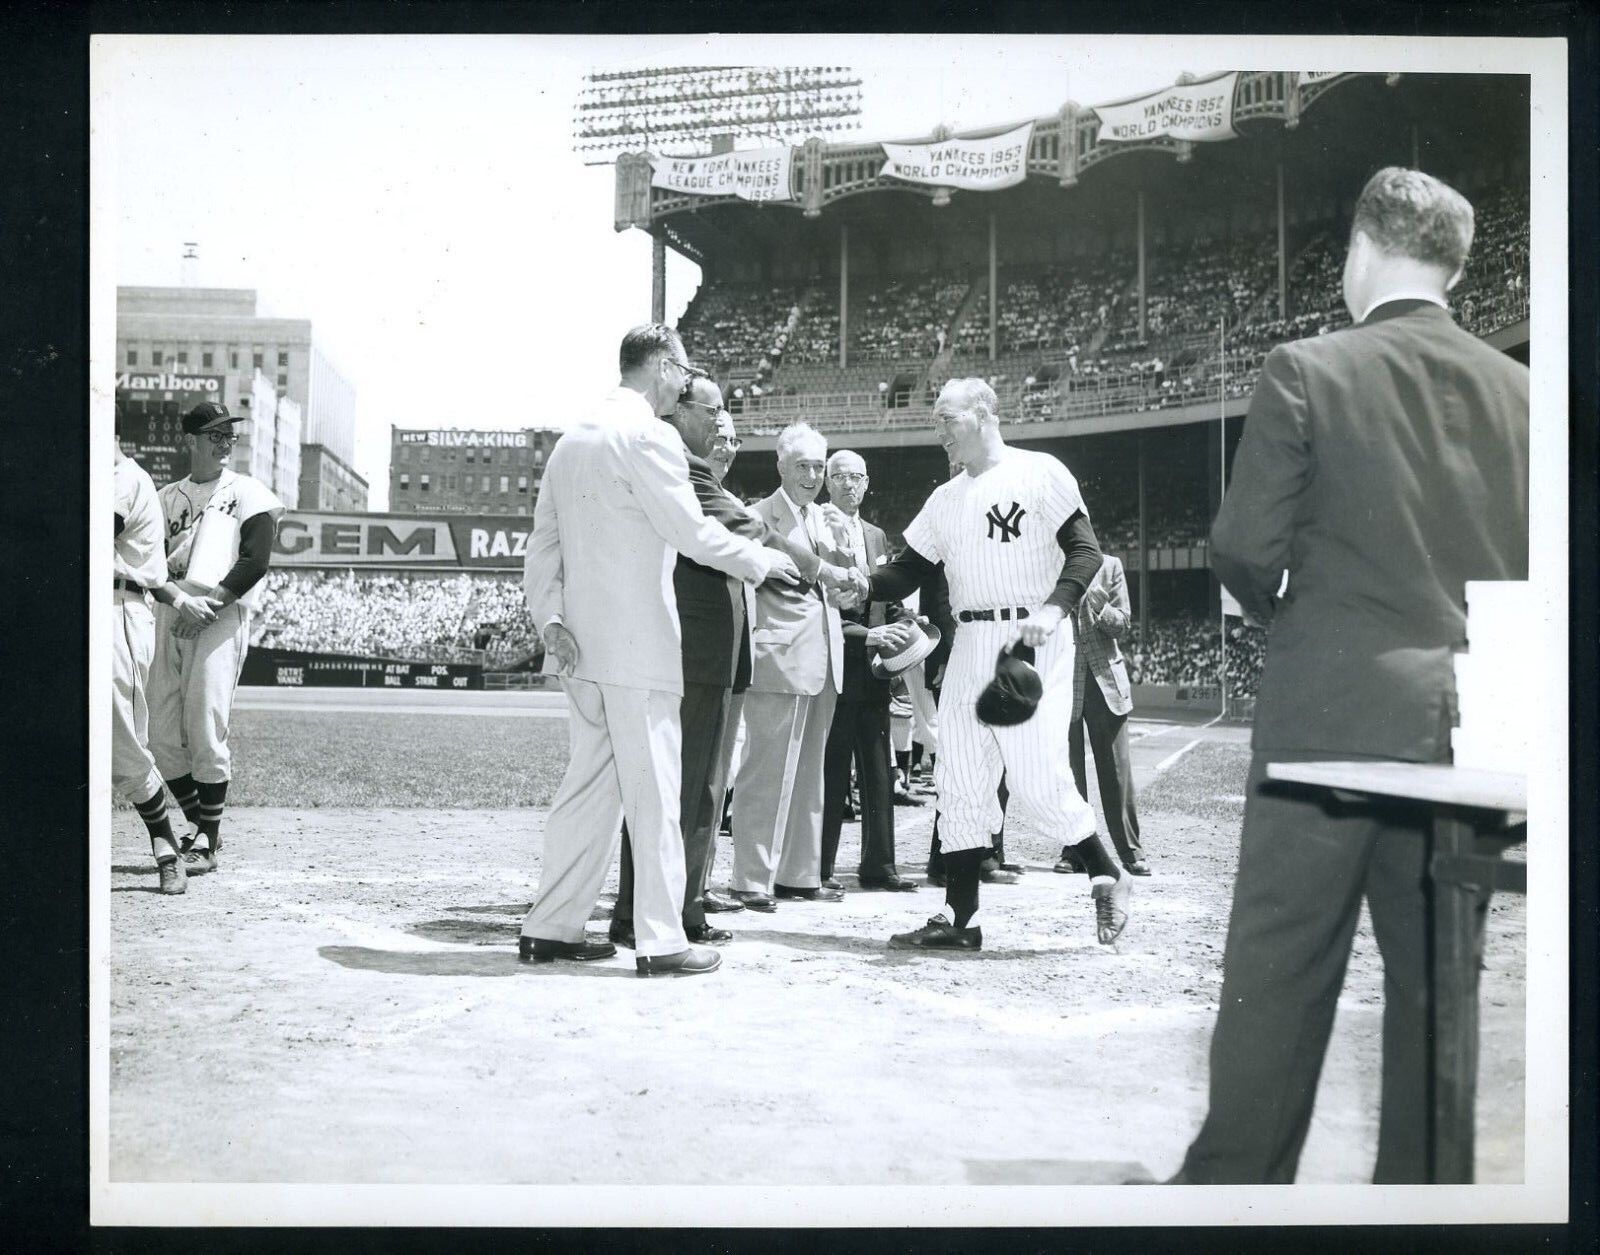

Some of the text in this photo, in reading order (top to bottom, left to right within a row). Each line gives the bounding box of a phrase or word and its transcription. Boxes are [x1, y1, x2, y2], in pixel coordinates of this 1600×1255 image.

[1112, 120, 1156, 138] WORLD
[930, 147, 985, 165] YANKEES
[672, 161, 696, 174] NEW
[894, 162, 1019, 178] WORLD CHAMPIONS
[668, 171, 779, 188] LEAGUE CHMPIONS
[402, 433, 426, 442] NEW
[985, 501, 1026, 542] NY
[271, 520, 436, 555] GEM
